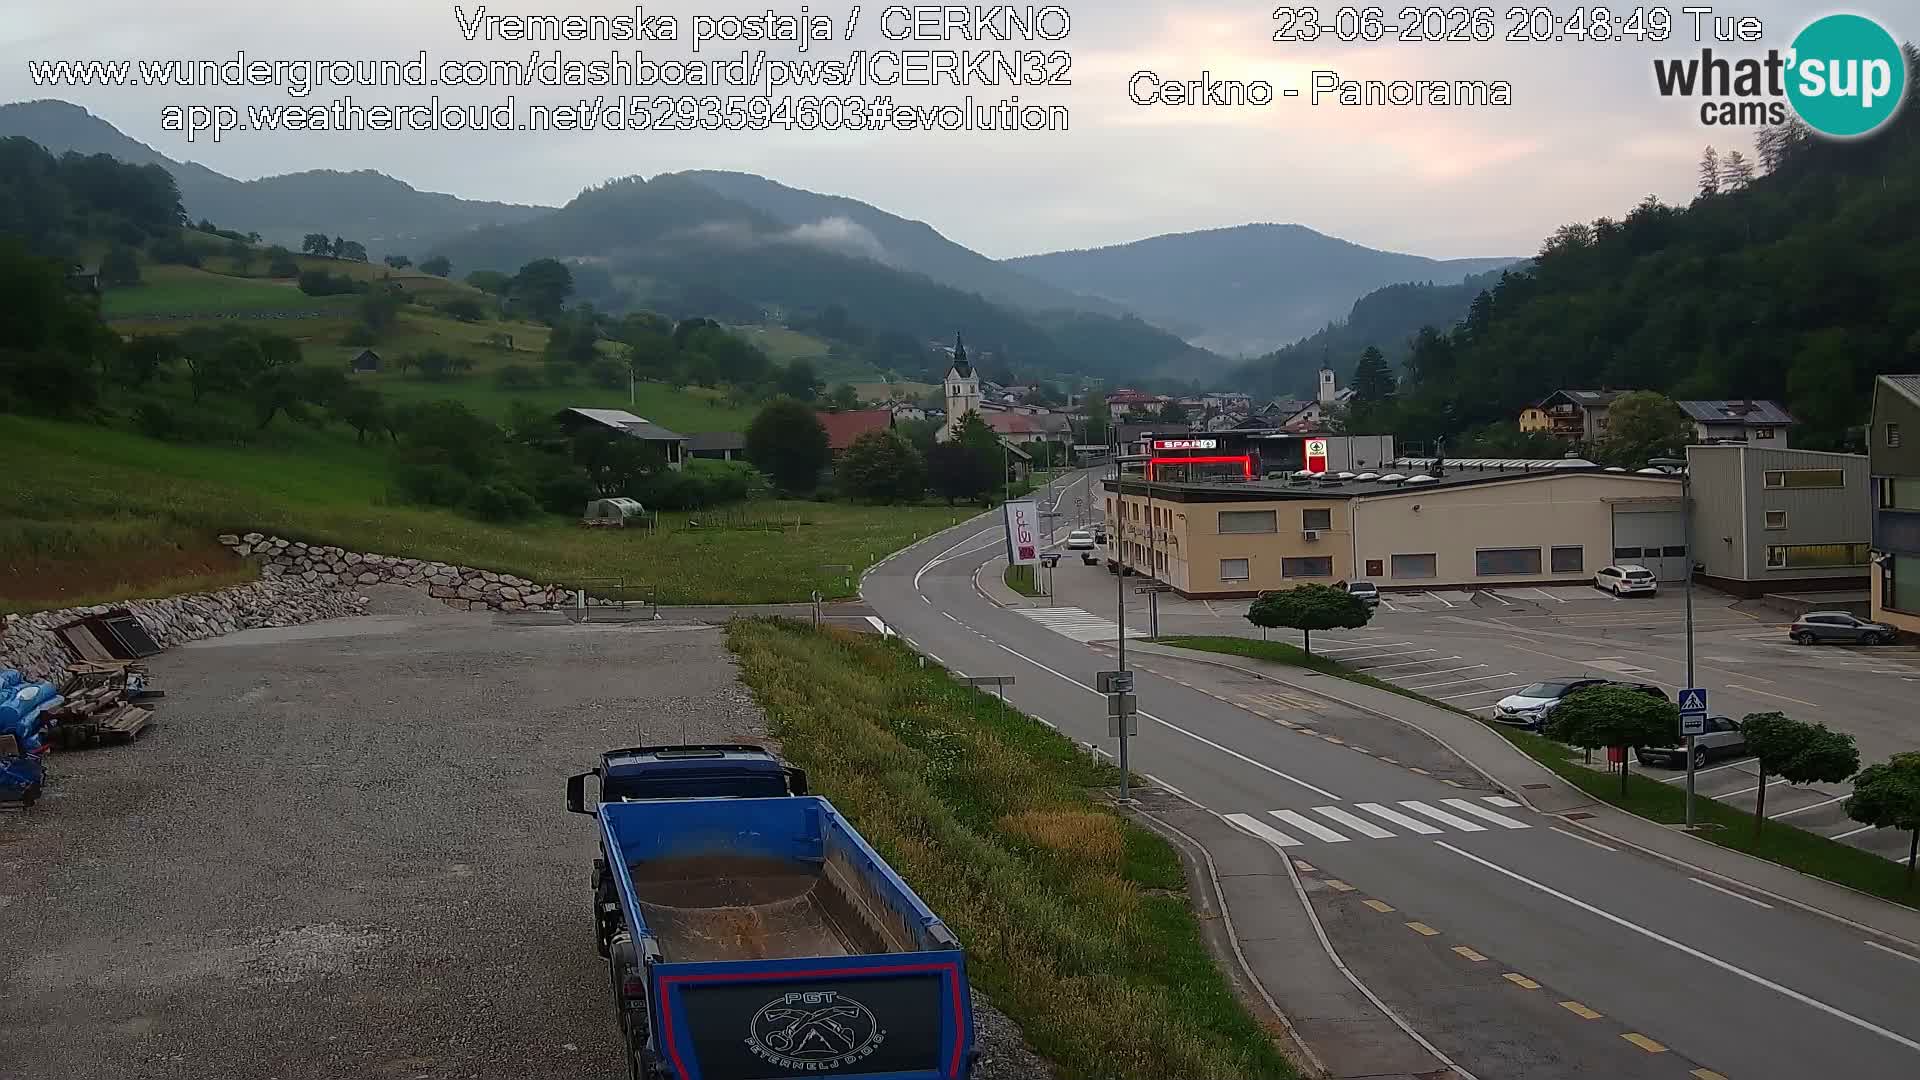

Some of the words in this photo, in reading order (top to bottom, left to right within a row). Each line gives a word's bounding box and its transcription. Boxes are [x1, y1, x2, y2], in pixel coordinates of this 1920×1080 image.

[1164, 441, 1201, 449] SPAR
[785, 991, 837, 1005] PGT
[744, 1036, 840, 1070] PETERNELJ
